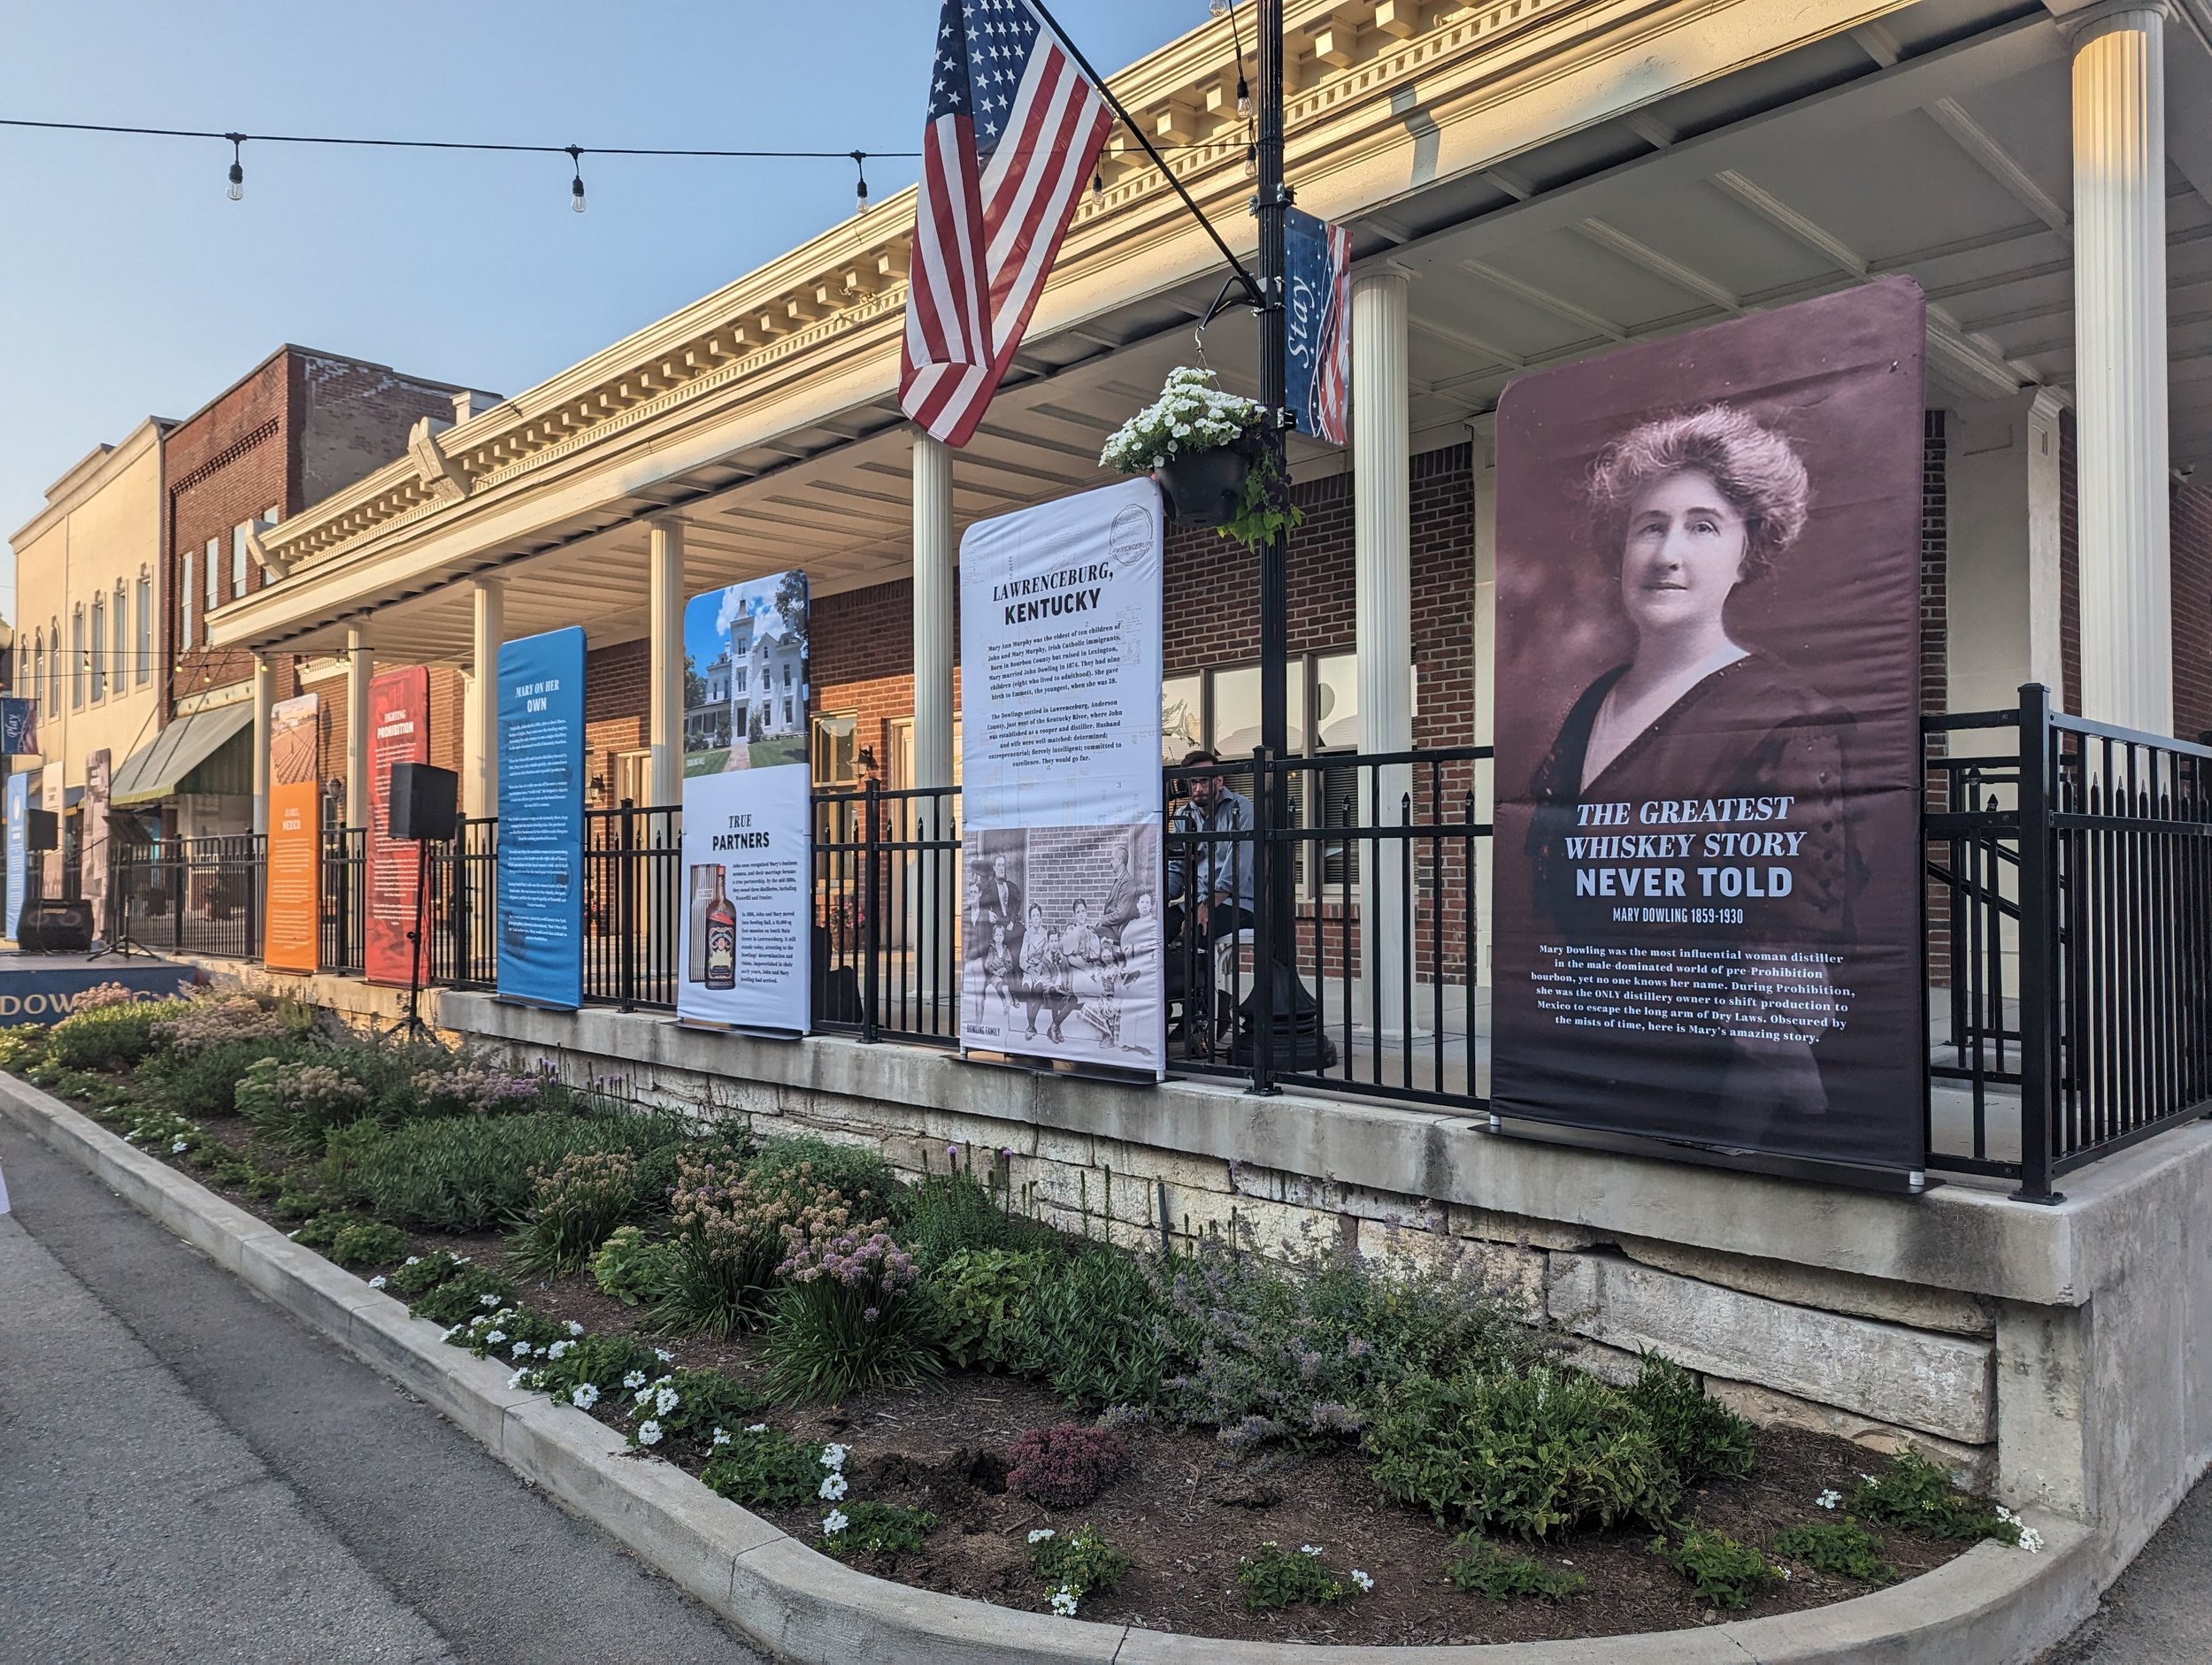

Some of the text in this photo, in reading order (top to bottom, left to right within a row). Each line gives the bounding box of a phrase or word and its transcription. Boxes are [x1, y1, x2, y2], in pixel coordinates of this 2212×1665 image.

[1287, 275, 1316, 369] Stay
[993, 562, 1114, 602] LAWRENCEBURG,
[1004, 587, 1102, 625] KENTUCKY
[1025, 646, 1048, 655] Murphy,
[1062, 640, 1085, 648] Catholic
[1086, 635, 1121, 644] immigrants.
[1002, 670, 1022, 679] married
[1060, 670, 1094, 679] adulthood).
[515, 679, 559, 698] MARY ON HER
[1043, 685, 1071, 694] youngest,
[526, 697, 547, 713] OWN
[1049, 703, 1090, 712] Lawrenceburg,
[5, 714, 22, 738] Play
[377, 721, 414, 740] PROHIBITION
[1577, 796, 1794, 826] THE GREATEST
[728, 814, 752, 829] TRUE
[712, 831, 770, 851] PARTNERS
[1564, 831, 1808, 861] WHISKEY STORY
[1576, 866, 1793, 897] NEVER TOLD
[1613, 907, 1743, 924] MARY DOWLING 1859-1930
[1540, 945, 1563, 955] Mary
[1566, 946, 1605, 956] Dowling
[1629, 947, 1647, 955] the
[1679, 948, 1740, 959] influential
[1791, 952, 1843, 963] distiller
[1555, 958, 1563, 967] in
[1567, 959, 1584, 968] the
[1676, 964, 1707, 973] world
[1710, 964, 1724, 973] of
[1531, 971, 1577, 983] bourbon,
[1633, 977, 1667, 986] knows
[1670, 978, 1689, 987] her
[1732, 981, 1772, 994] During
[1776, 984, 1855, 997] Prohibition,
[1536, 986, 1553, 994] she
[1576, 988, 1592, 997] the
[1594, 989, 1621, 999] ONLY
[1624, 991, 1673, 1003] distillery
[1728, 997, 1757, 1007] shift
[1761, 999, 1831, 1010] production
[1537, 1000, 1571, 1009] Mexico
[1586, 1005, 1620, 1015] escape
[1624, 1005, 1640, 1014] the
[1644, 1006, 1667, 1018] long
[1696, 1009, 1709, 1018] of
[1711, 1010, 1732, 1022] Dry
[1734, 1012, 1767, 1022] Laws.
[1770, 1015, 1828, 1026] Obscured
[1832, 1017, 1846, 1030] by
[966, 1024, 1001, 1037] DOWLING FAMILY
[1555, 1015, 1820, 1044] the mists of time, here is Mary's amazing story.
